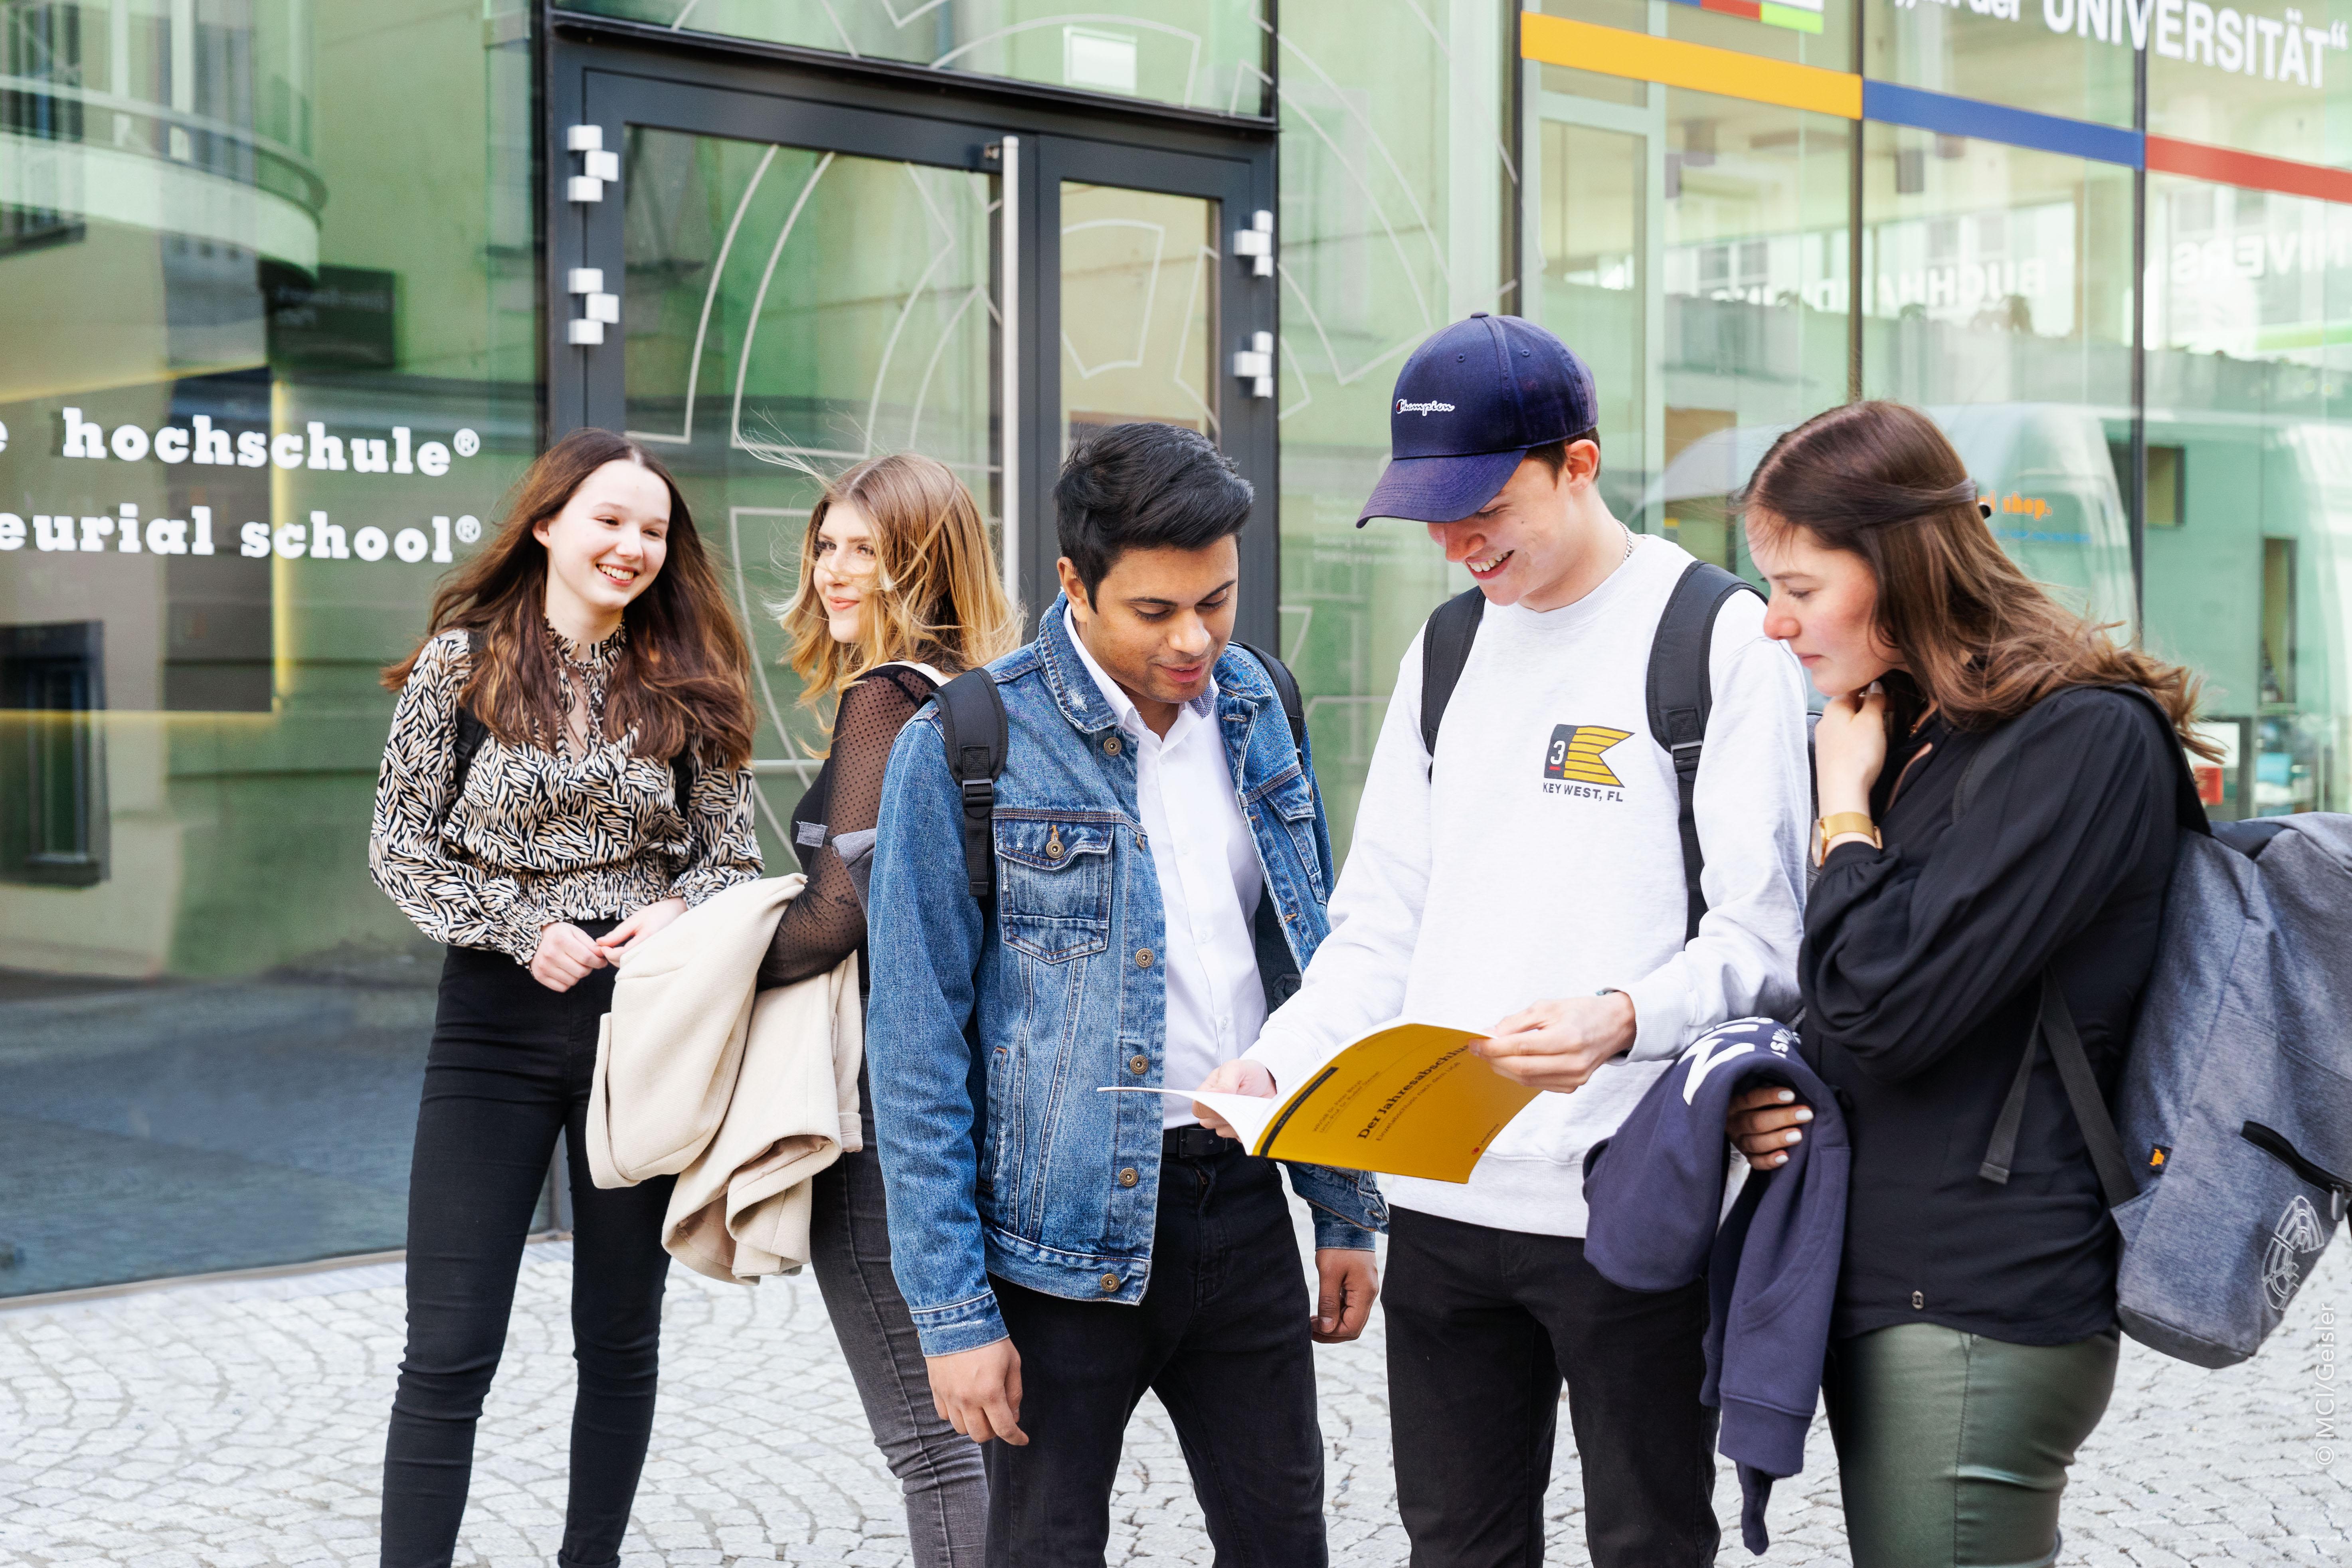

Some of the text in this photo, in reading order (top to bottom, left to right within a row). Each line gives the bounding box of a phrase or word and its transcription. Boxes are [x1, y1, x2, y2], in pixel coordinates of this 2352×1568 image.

[1396, 399, 1455, 416] Champion
[1550, 740, 1565, 765] 3
[1543, 783, 1623, 802] KEY WEST, FL
[1357, 1044, 1469, 1139] Der Jahresabschlus
